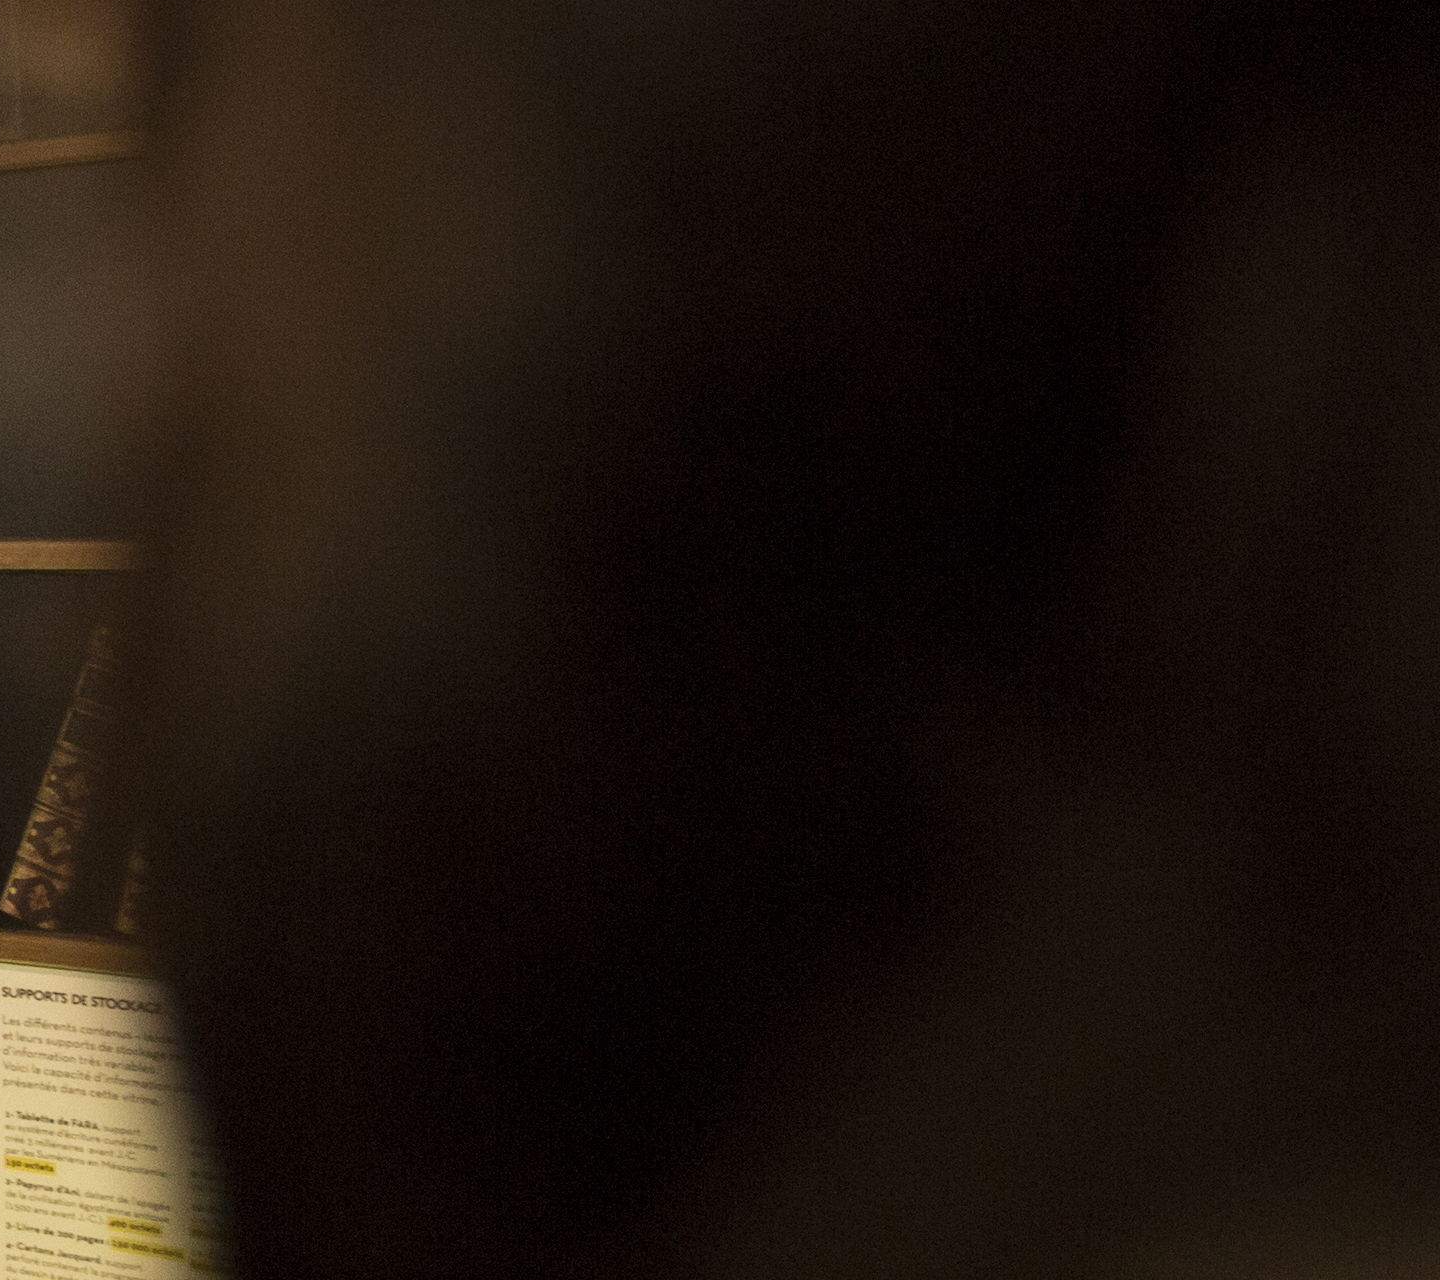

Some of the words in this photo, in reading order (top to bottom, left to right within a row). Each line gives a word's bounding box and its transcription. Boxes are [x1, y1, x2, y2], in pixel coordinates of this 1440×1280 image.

[0, 986, 68, 1004] SUPPORTS
[70, 994, 88, 1006] DE
[2, 1015, 20, 1027] Les
[22, 1017, 76, 1032] différents
[80, 1026, 132, 1038] contenus
[2, 1031, 12, 1040] et
[14, 1030, 42, 1044] leurs
[46, 1038, 96, 1050] supports
[98, 1040, 112, 1052] de
[2, 1044, 76, 1064] d'information
[78, 1055, 100, 1066] très
[2, 1060, 28, 1073] Voici
[30, 1063, 40, 1074] la
[42, 1068, 92, 1080] capacité
[2, 1078, 58, 1092] présentés
[60, 1082, 86, 1096] dans
[88, 1089, 118, 1100] cette
[16, 1110, 54, 1124] Tablette
[56, 1116, 68, 1126] de
[24, 1162, 56, 1172] octets
[4, 1188, 16, 1198] de
[18, 1190, 26, 1200] la
[16, 1178, 54, 1192] Papyrus
[116, 1194, 130, 1204] de
[50, 1210, 76, 1219] avant
[16, 1222, 40, 1233] Livre
[42, 1226, 54, 1235] de
[76, 1234, 104, 1244] pages
[16, 1242, 54, 1256] Cartons
